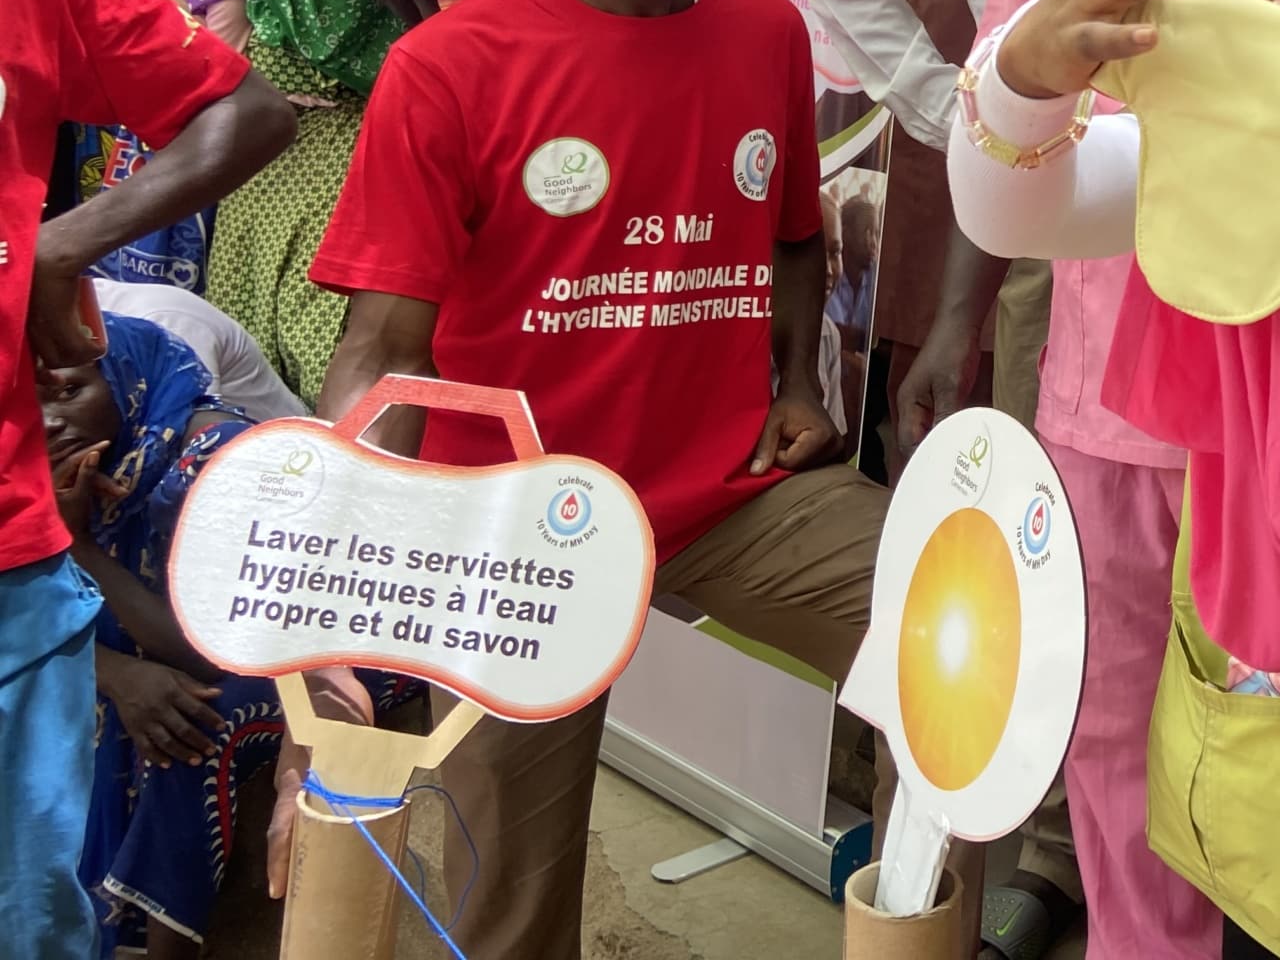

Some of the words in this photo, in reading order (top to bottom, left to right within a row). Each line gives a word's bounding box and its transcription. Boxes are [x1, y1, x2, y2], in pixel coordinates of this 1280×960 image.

[544, 176, 573, 187] Good
[545, 184, 592, 196] Neighbors
[624, 215, 664, 245] 28
[674, 213, 714, 243] Mai
[541, 267, 649, 301] JOURNÉE
[653, 265, 749, 294] MONDIALE
[754, 265, 773, 287] D
[522, 301, 645, 333] L'HYGIÈNE
[957, 456, 970, 471] Good
[258, 484, 304, 498] Neighbors
[260, 474, 285, 485] Good
[558, 476, 594, 491] Celebrate
[1035, 482, 1055, 506] Celebrate
[563, 504, 577, 516] 10
[536, 519, 545, 530] 10
[541, 528, 558, 546] Years
[560, 540, 568, 548] of
[570, 537, 584, 548] MH
[583, 525, 598, 540] Day
[1033, 516, 1043, 530] 10
[248, 520, 339, 557] Laver
[347, 534, 395, 565] les
[405, 549, 575, 590] serviettes
[1017, 538, 1027, 563] Years
[1040, 549, 1051, 565] Day
[238, 554, 436, 608] hygiéniques
[446, 584, 466, 613] à
[477, 588, 557, 624] l'eau
[228, 596, 338, 630] propre
[349, 611, 383, 637] et
[393, 614, 433, 645] du
[443, 627, 540, 660] savon
